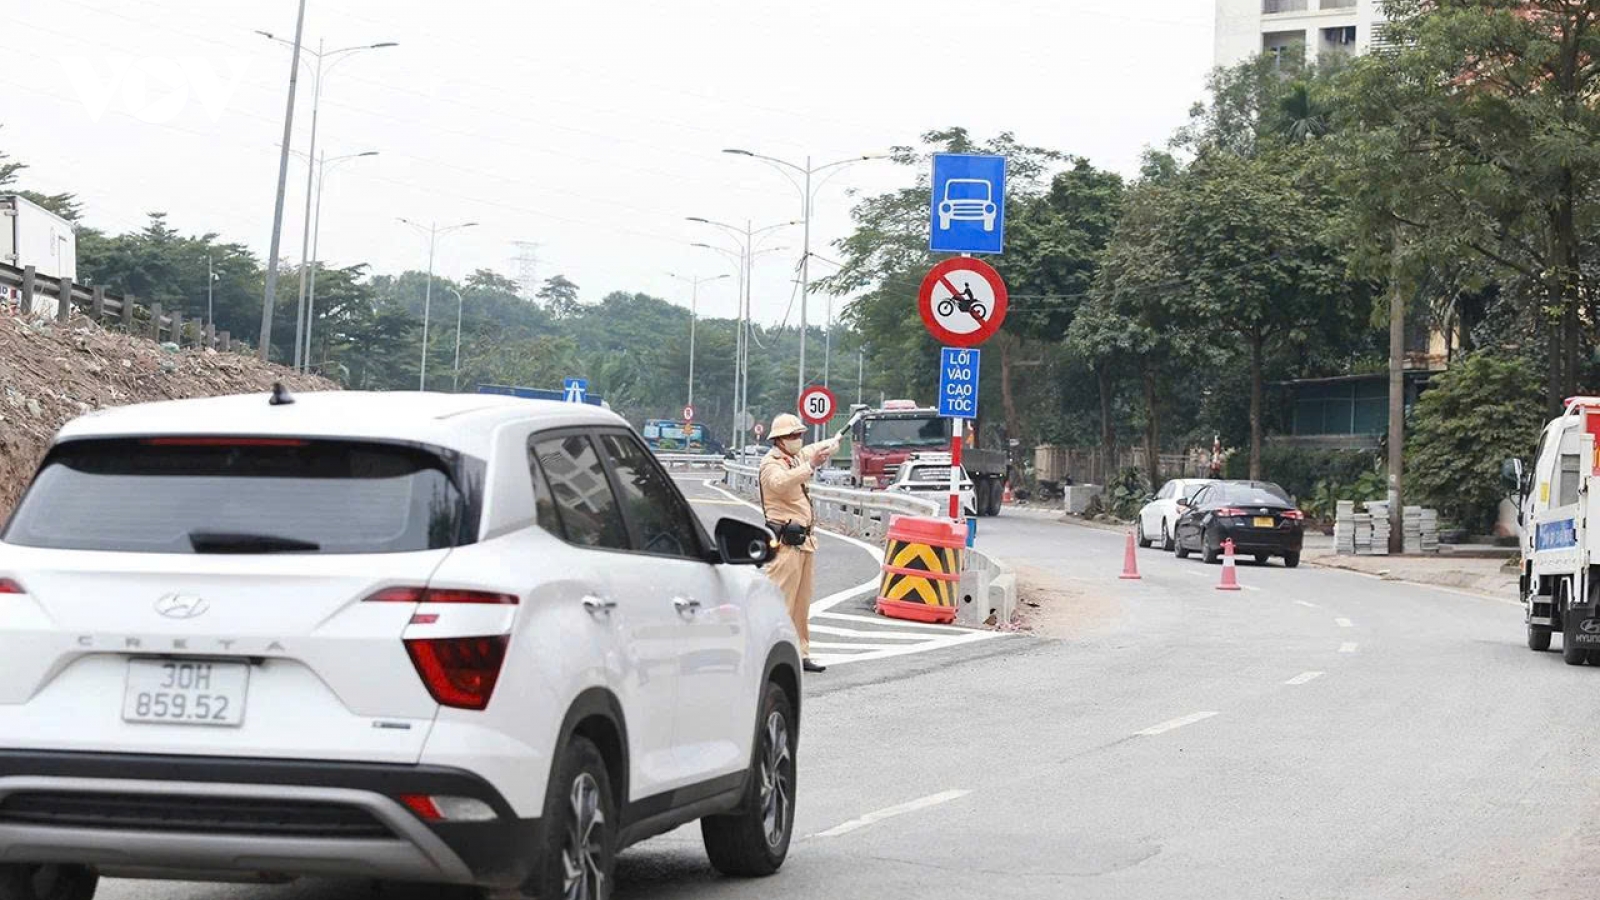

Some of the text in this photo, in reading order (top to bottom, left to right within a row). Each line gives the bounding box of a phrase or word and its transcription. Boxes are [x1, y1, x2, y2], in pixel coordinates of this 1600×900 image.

[949, 350, 970, 365] LỐI
[947, 365, 971, 380] VÀO
[947, 384, 972, 396] CAO
[810, 397, 825, 414] 50
[947, 395, 972, 411] TỐC
[77, 636, 286, 651] CRETA
[160, 663, 212, 690] 30H
[135, 692, 229, 720] 859.52
